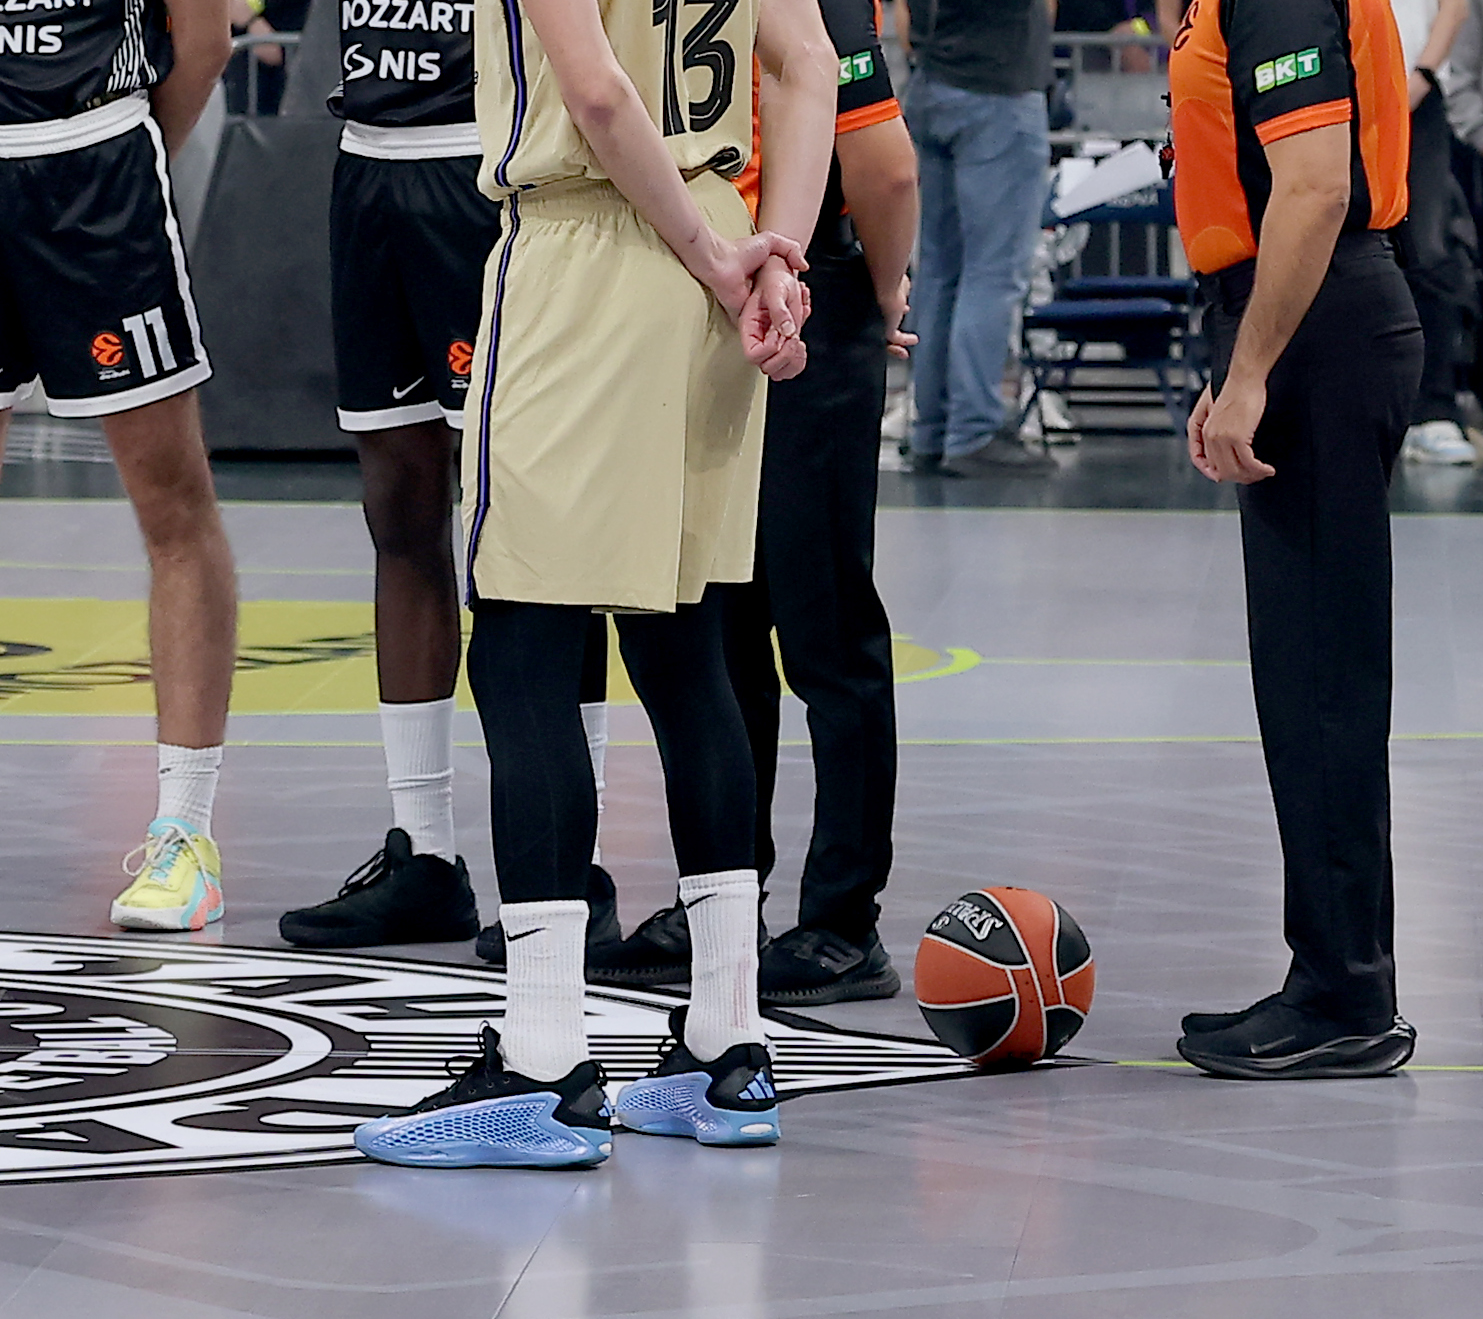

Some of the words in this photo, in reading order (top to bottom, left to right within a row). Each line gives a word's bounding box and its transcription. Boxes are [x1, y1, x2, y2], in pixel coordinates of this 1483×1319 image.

[379, 49, 441, 81] NIS
[1255, 48, 1321, 90] BKT
[122, 307, 177, 378] 11
